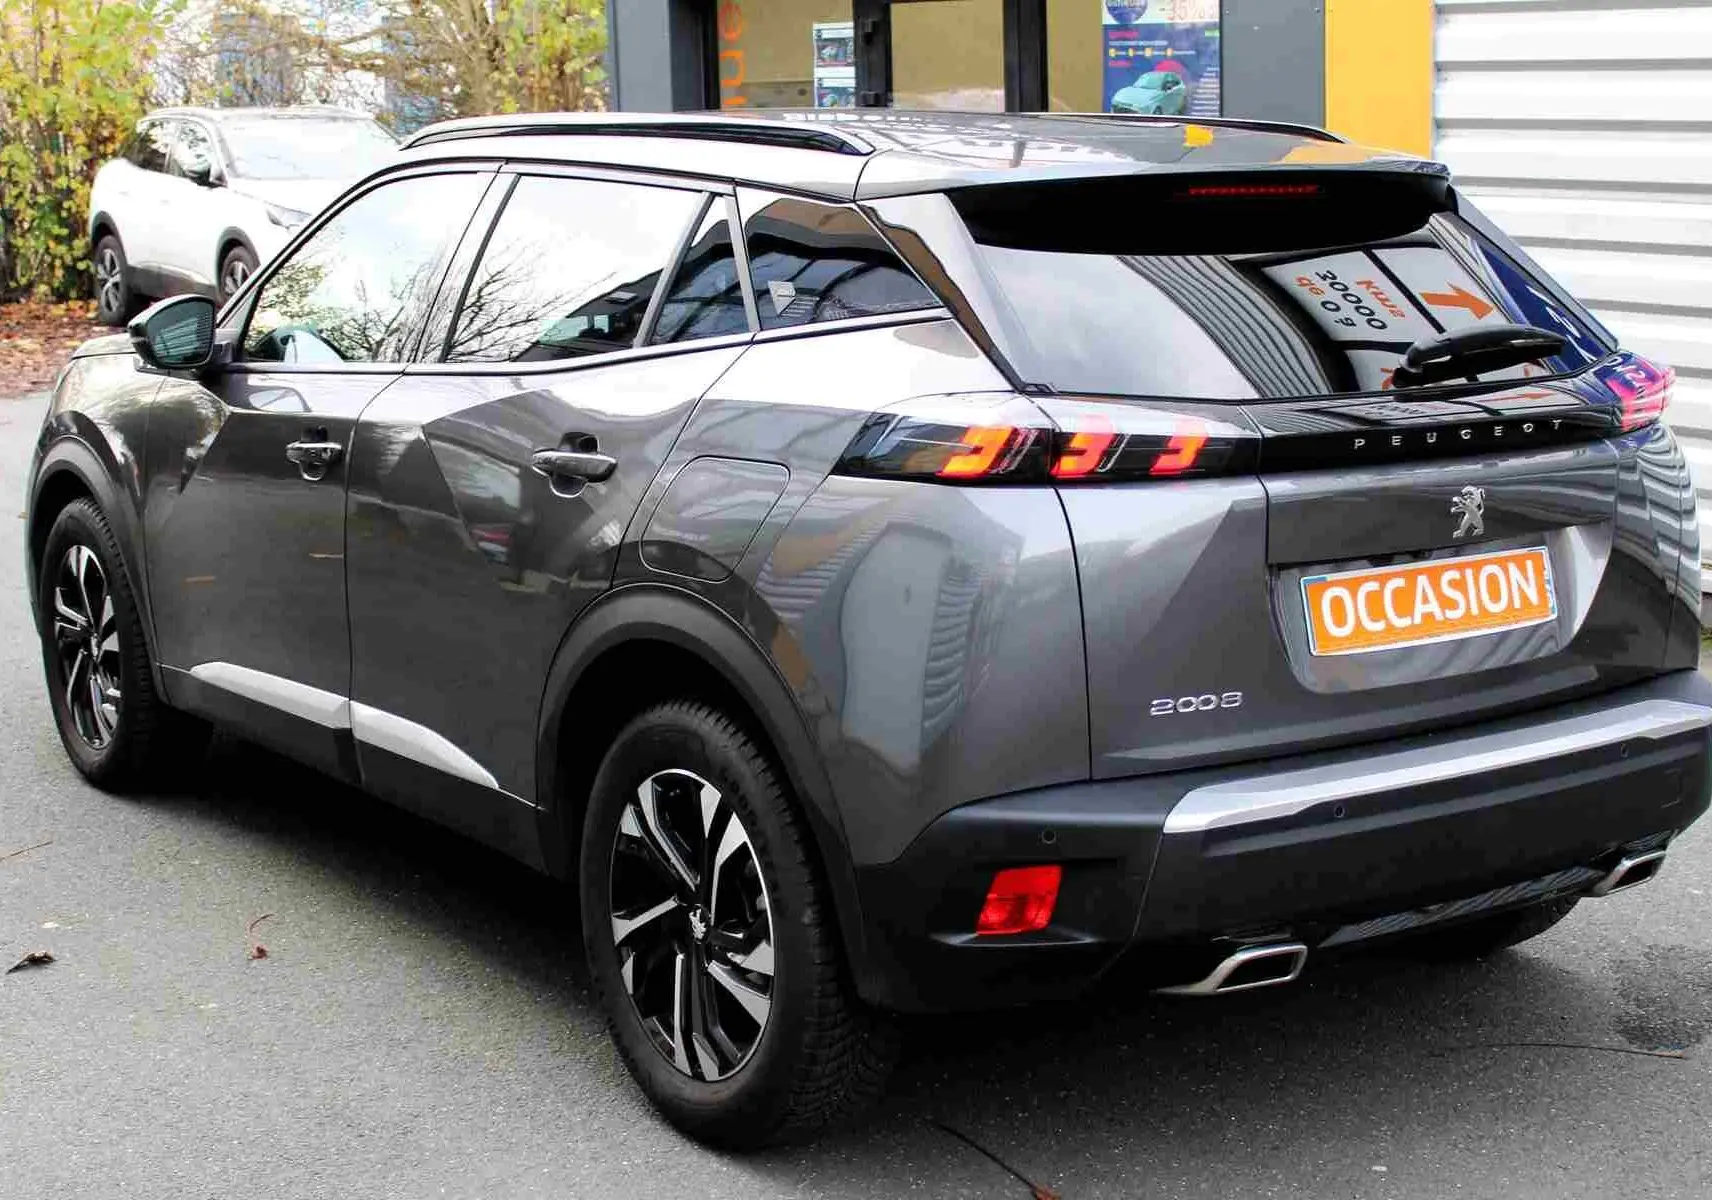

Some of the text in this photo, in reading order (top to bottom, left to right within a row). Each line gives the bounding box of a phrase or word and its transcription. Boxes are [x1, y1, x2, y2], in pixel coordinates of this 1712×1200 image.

[1353, 419, 1562, 449] PEUGEOT
[1320, 559, 1539, 638] OCCASION
[1150, 691, 1243, 716] 2008
